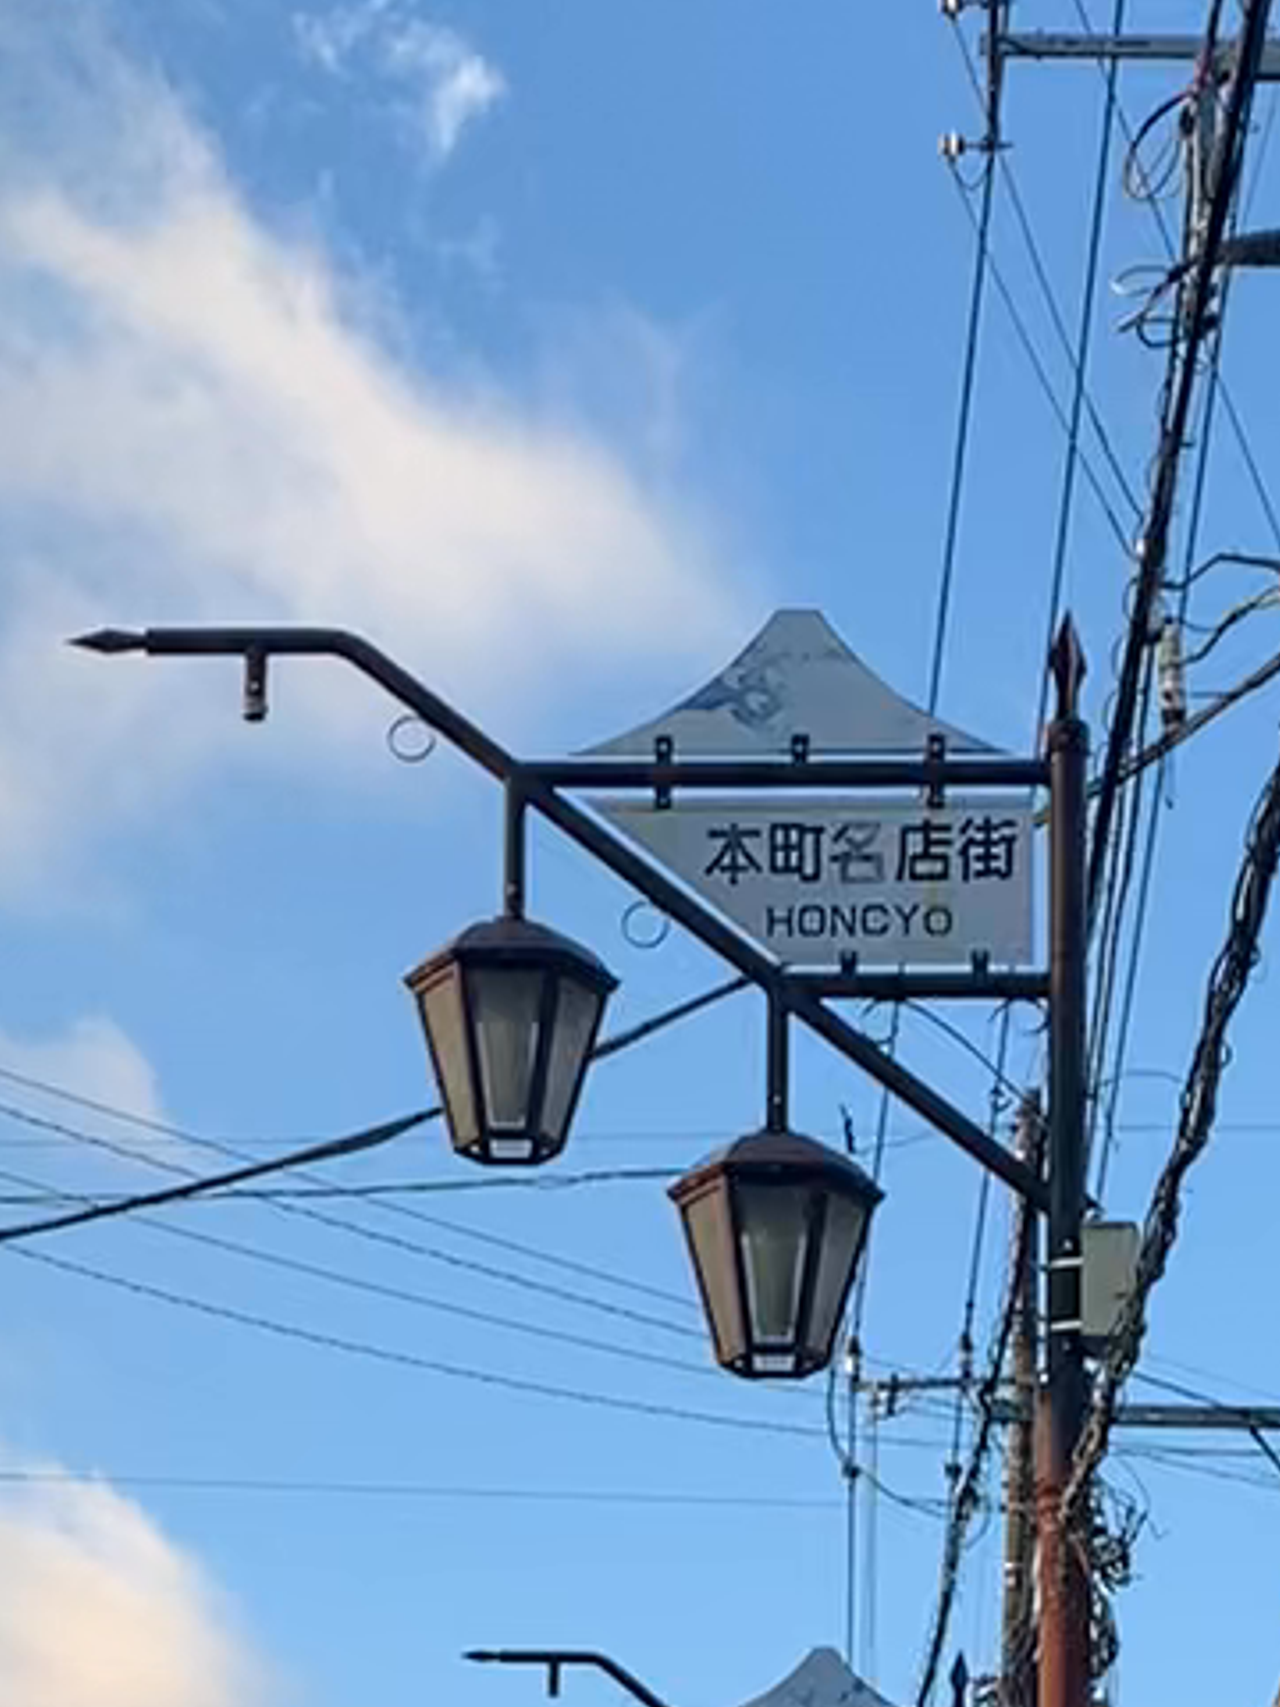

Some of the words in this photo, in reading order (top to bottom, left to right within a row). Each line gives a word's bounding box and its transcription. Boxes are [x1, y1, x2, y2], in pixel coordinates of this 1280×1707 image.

[705, 815, 1018, 886] 本町名店街
[766, 904, 954, 938] HONCYO
